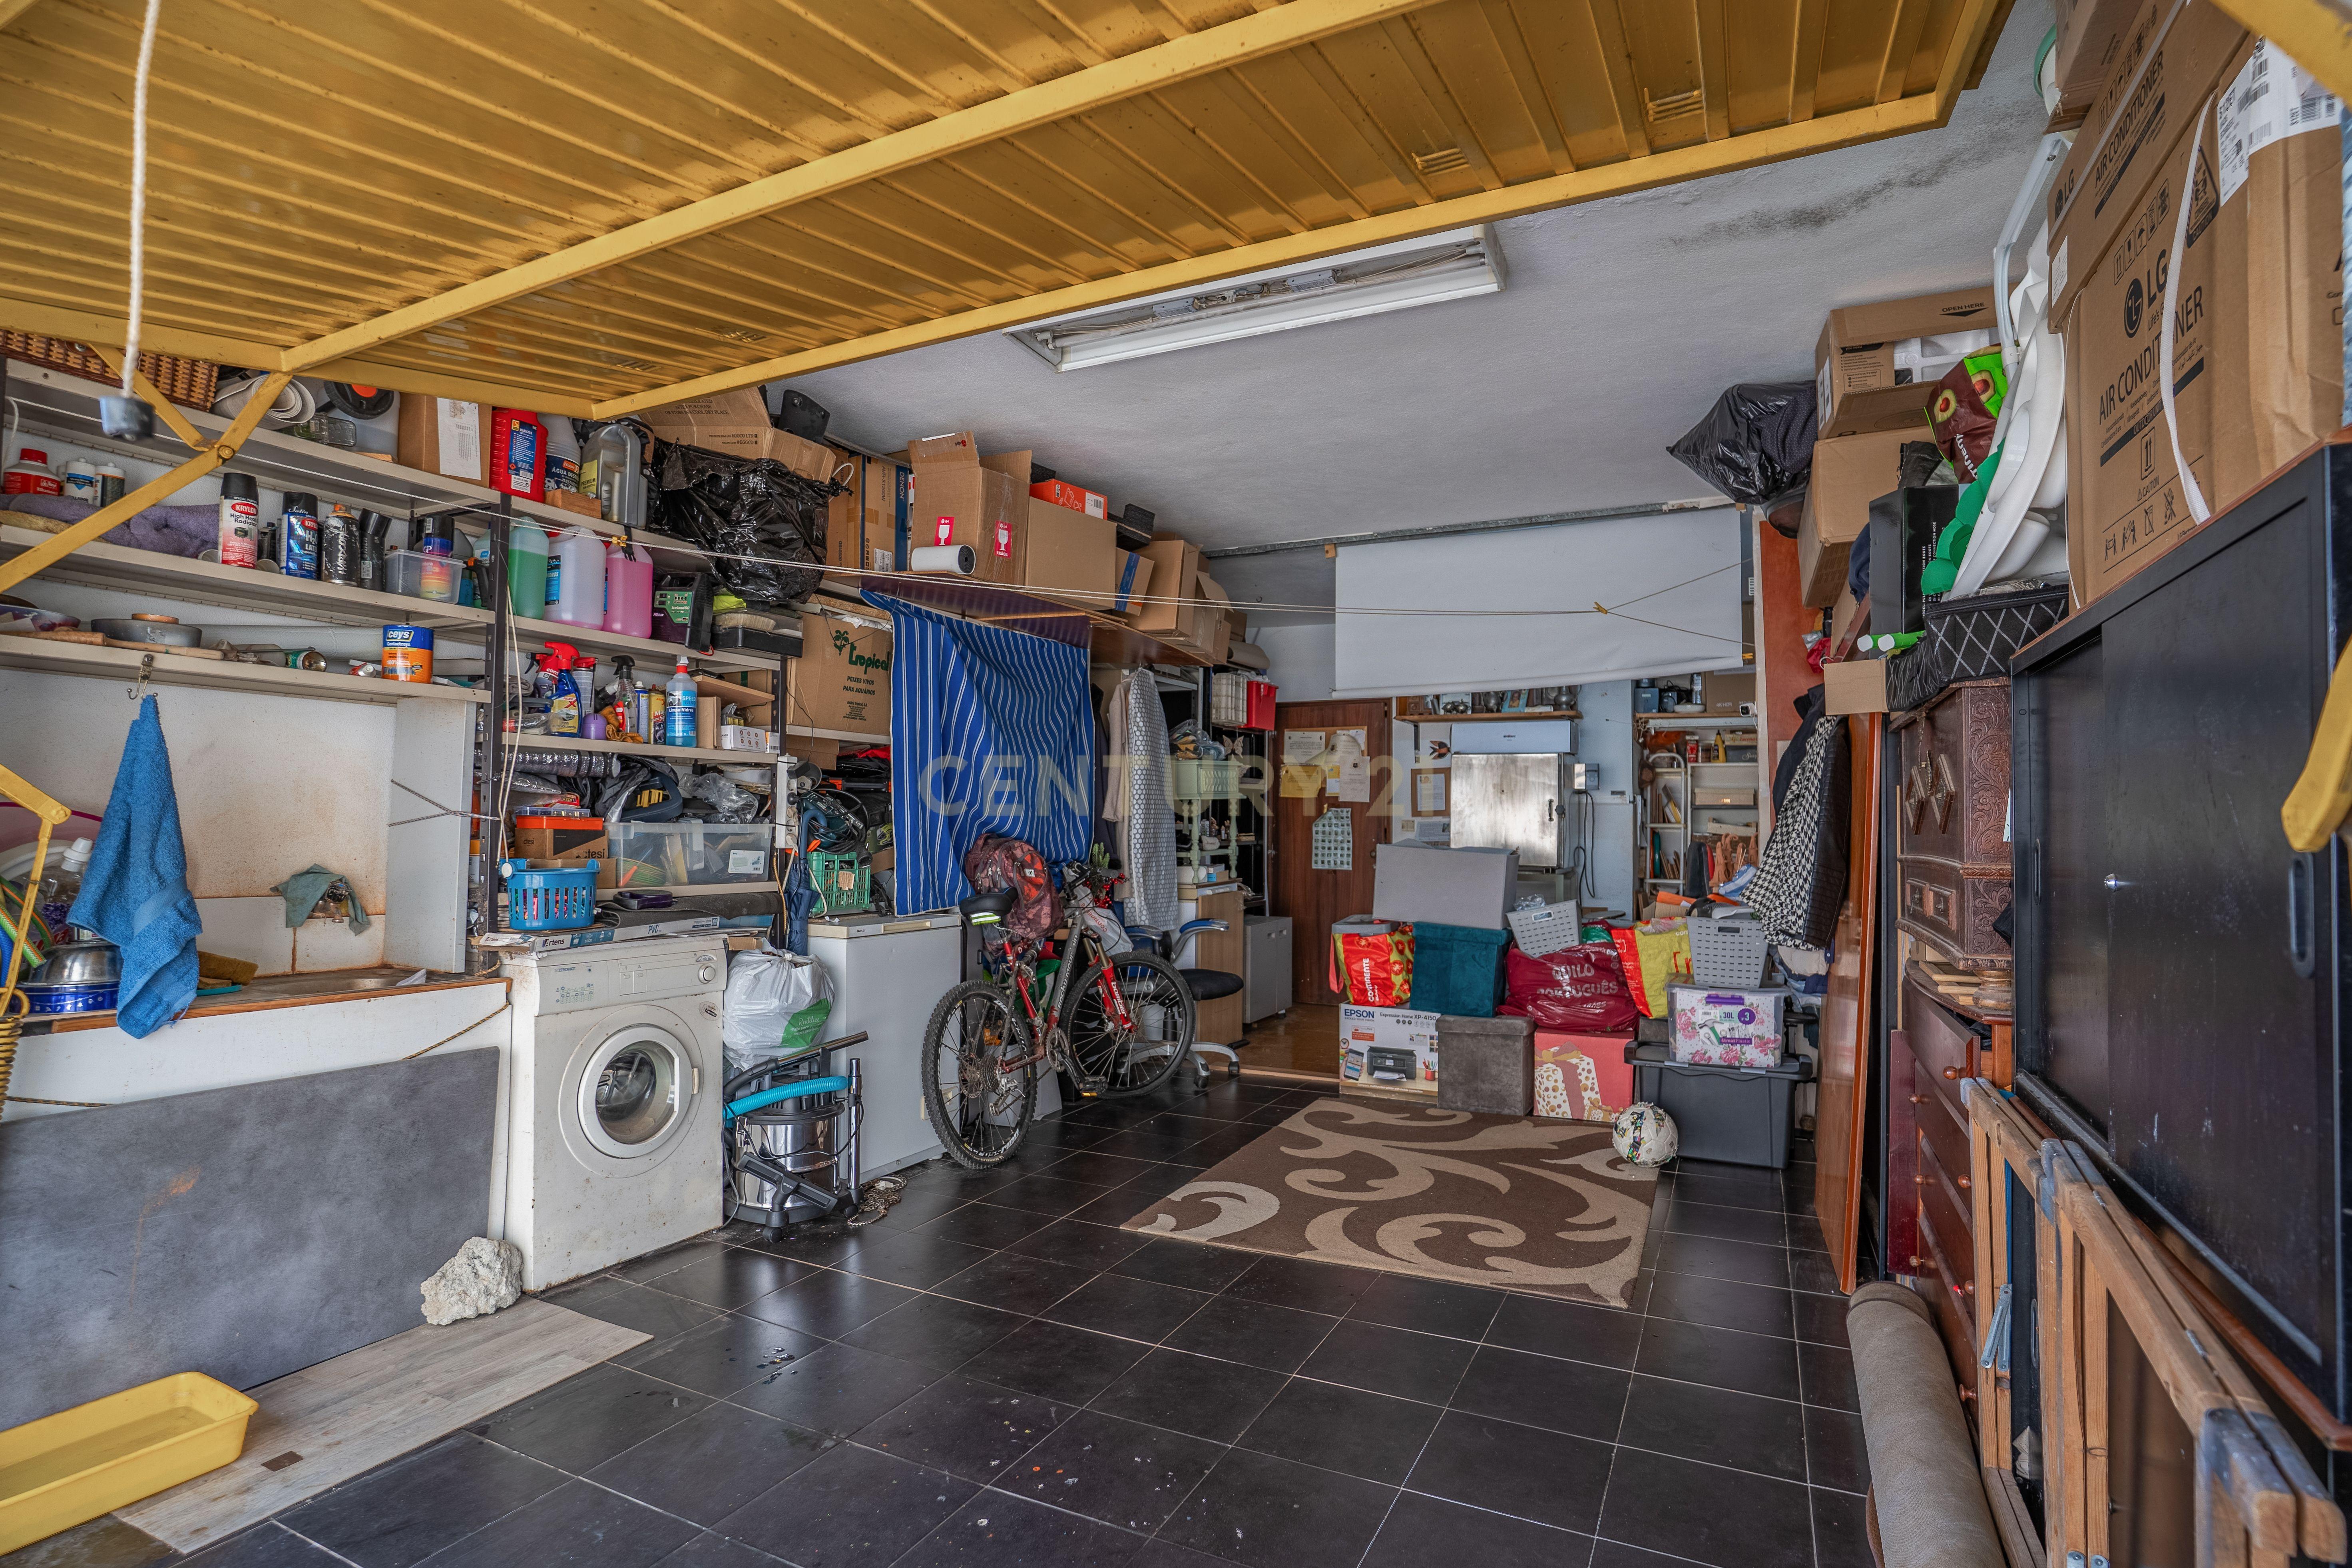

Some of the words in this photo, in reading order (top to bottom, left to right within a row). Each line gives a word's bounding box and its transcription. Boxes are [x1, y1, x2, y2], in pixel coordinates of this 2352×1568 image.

[2095, 153, 2107, 189] AIR
[2109, 50, 2163, 163] CONDITIONER
[2063, 168, 2074, 204] LG
[2147, 249, 2167, 309] LG
[2148, 309, 2160, 331] Life's
[2099, 384, 2116, 425] AIR
[2118, 285, 2203, 403] CONDITNER
[552, 466, 567, 476] ÁGUA
[2143, 475, 2159, 497] CAUTION
[235, 504, 257, 514] KRYLON
[289, 506, 309, 514] Satin
[235, 518, 257, 527] Radiator
[388, 631, 410, 639] ceys
[848, 642, 890, 675] tropical
[648, 924, 659, 934] PVC
[542, 938, 564, 948] Artens
[1363, 958, 1374, 1002] CONTINENTE
[1552, 963, 1595, 980] QUILO
[1111, 982, 1127, 1016] bomber
[1344, 1009, 1374, 1019] EPSON
